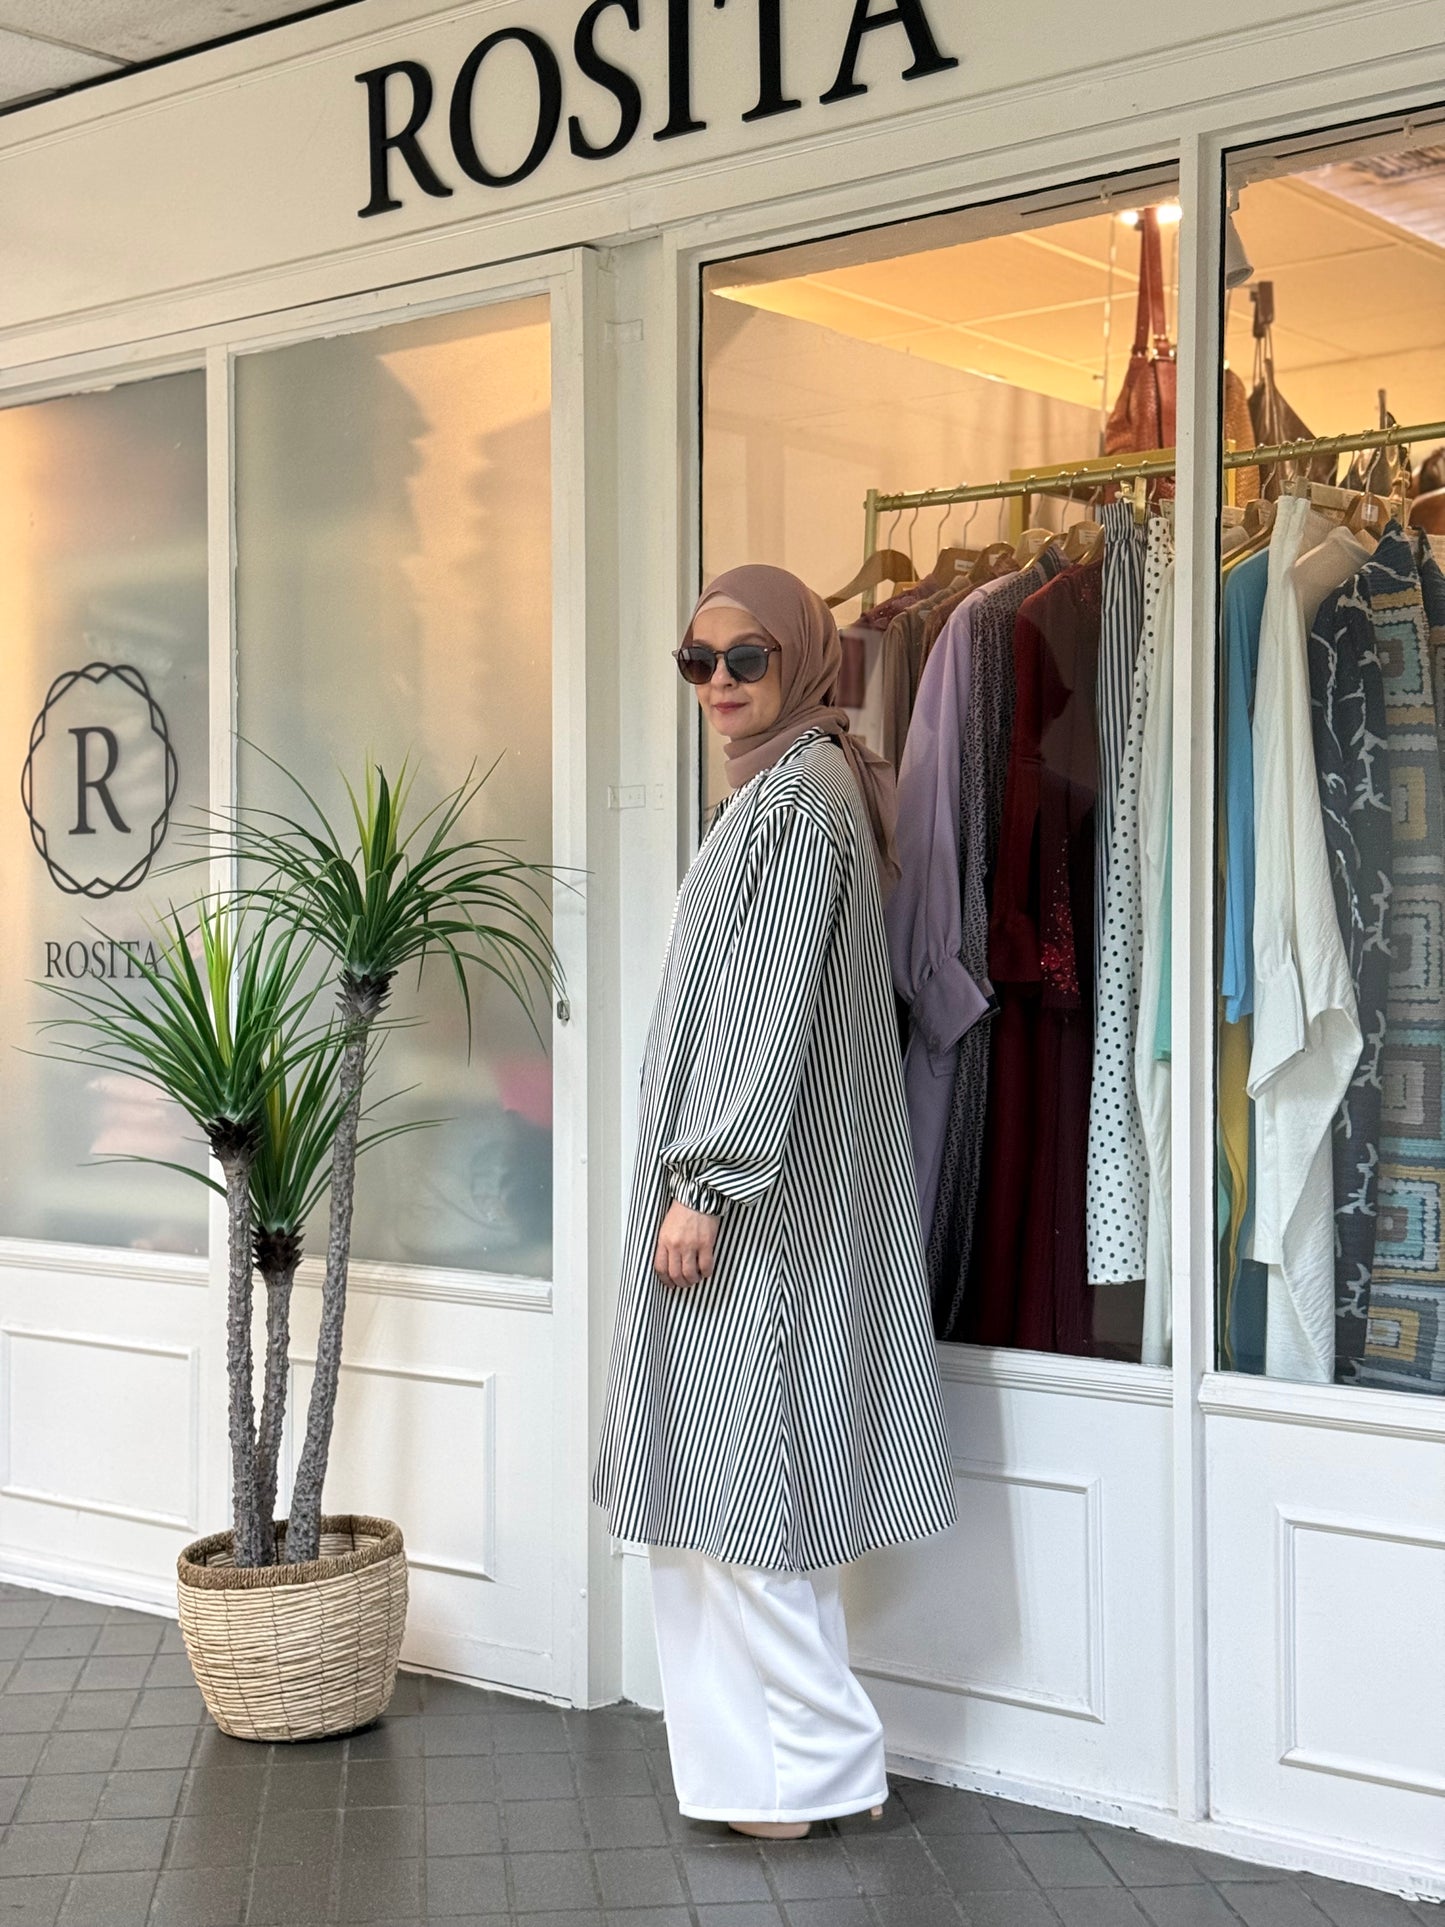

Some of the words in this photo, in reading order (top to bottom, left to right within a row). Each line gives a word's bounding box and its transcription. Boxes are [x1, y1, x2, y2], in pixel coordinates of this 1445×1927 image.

[355, 0, 959, 218] ROSITA
[68, 726, 131, 835] R
[44, 940, 161, 979] ROSITA
